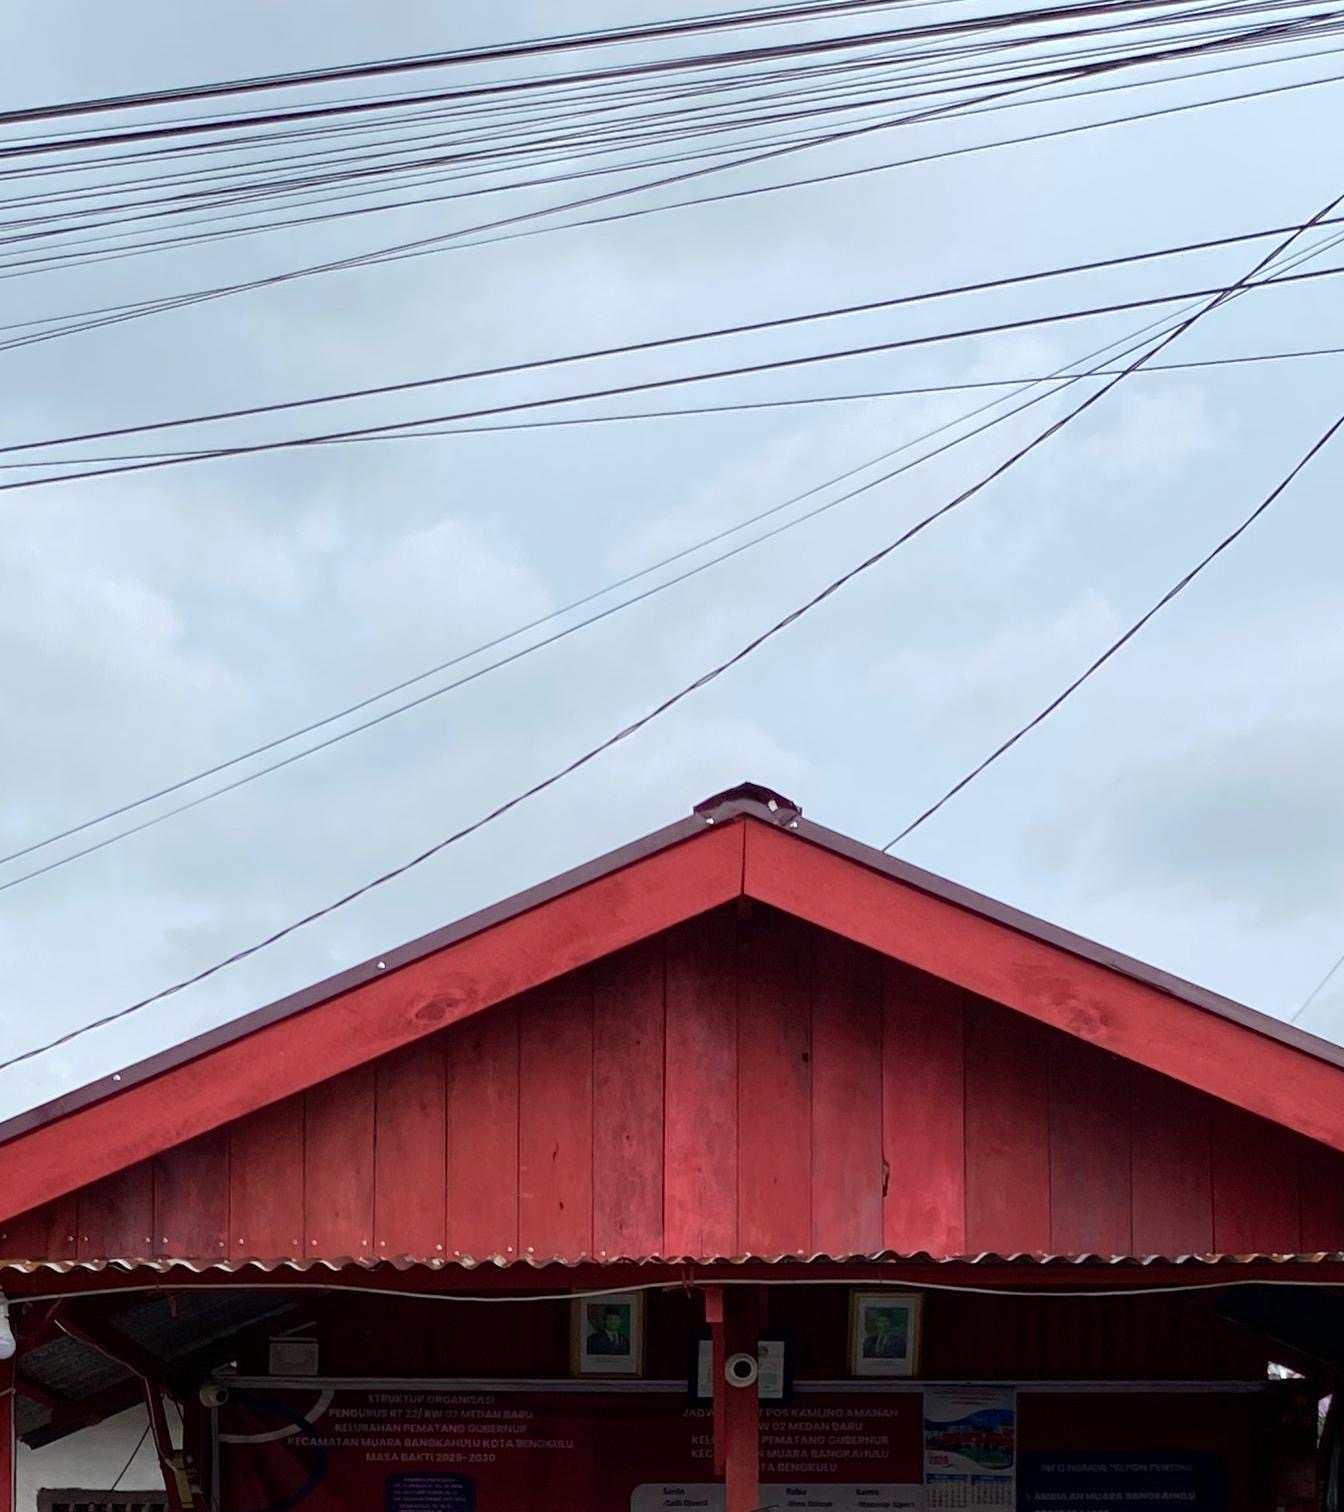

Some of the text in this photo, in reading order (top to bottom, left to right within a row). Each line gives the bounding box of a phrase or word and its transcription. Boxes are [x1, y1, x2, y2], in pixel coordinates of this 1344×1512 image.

[766, 1408, 789, 1417] POS
[334, 1423, 401, 1433] KELURAHAN
[403, 1424, 465, 1433] PEMATANG
[788, 1422, 830, 1431] MEDAN
[361, 1438, 402, 1447] MUARA
[482, 1439, 514, 1448] KOTA
[762, 1436, 825, 1445] PEMATANG
[366, 1453, 399, 1462] MASA
[401, 1453, 434, 1462] BAKTI
[767, 1450, 808, 1458] MUARA
[777, 1463, 837, 1472] BENGKULU
